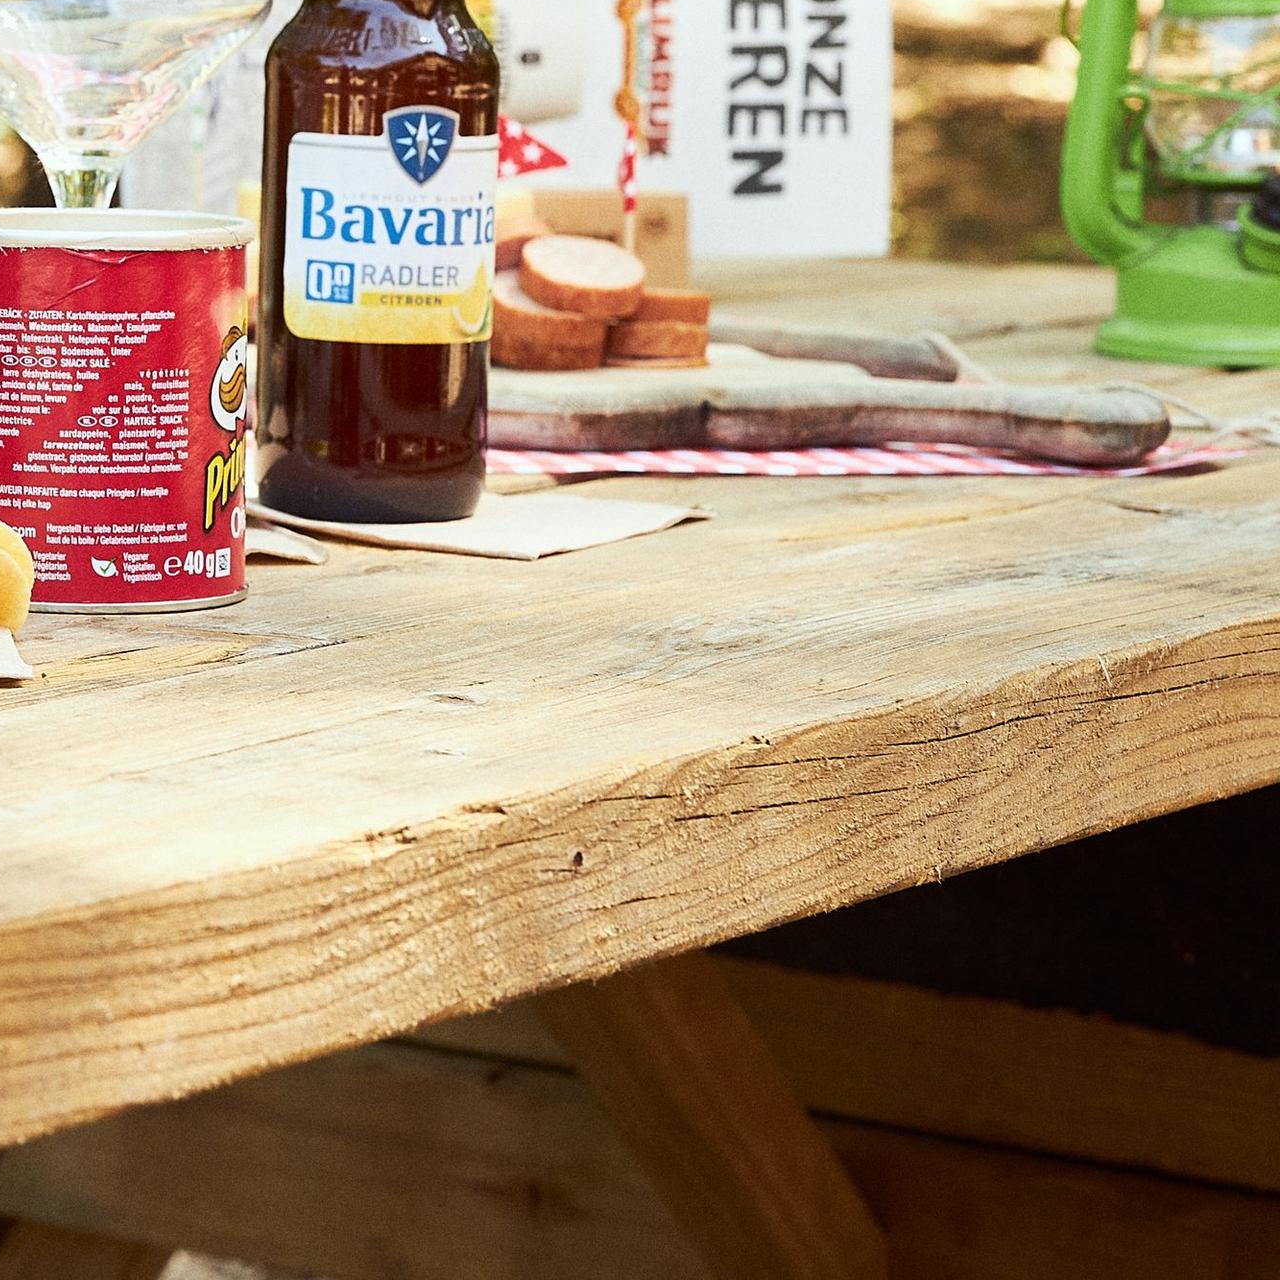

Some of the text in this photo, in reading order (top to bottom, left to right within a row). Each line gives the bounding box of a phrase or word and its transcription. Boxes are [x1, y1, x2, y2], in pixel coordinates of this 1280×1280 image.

[361, 264, 460, 287] RADLER
[380, 294, 443, 305] CITROEN
[28, 310, 65, 320] ZUTATEN:
[35, 345, 57, 356] Siehe
[110, 346, 133, 356] Unter
[60, 358, 87, 368] SNACK
[76, 371, 100, 381] huiles
[108, 394, 119, 403] en
[160, 391, 189, 402] colorant
[92, 405, 107, 415] voir
[109, 407, 121, 415] sur
[123, 417, 157, 426] HARTIGE
[159, 416, 183, 425] SNACK
[59, 429, 112, 440] aardappelen,
[118, 428, 166, 440] plantaardige
[155, 440, 189, 450] emulgator
[50, 463, 78, 475] Verpakt
[78, 464, 100, 474] onder
[100, 463, 151, 474] beschermende
[23, 485, 59, 497] PARFAITE
[59, 488, 78, 497] dans
[78, 488, 106, 500] chaque
[106, 488, 135, 499] Pringles
[22, 498, 37, 508] elke
[37, 499, 52, 511] hap
[93, 523, 111, 533] siehe
[112, 523, 134, 533] Deckel
[46, 535, 61, 545] haut
[61, 535, 71, 545] de
[33, 551, 66, 562] Vegetarier
[122, 551, 150, 562] Veganer
[122, 571, 162, 583] Veganistisch
